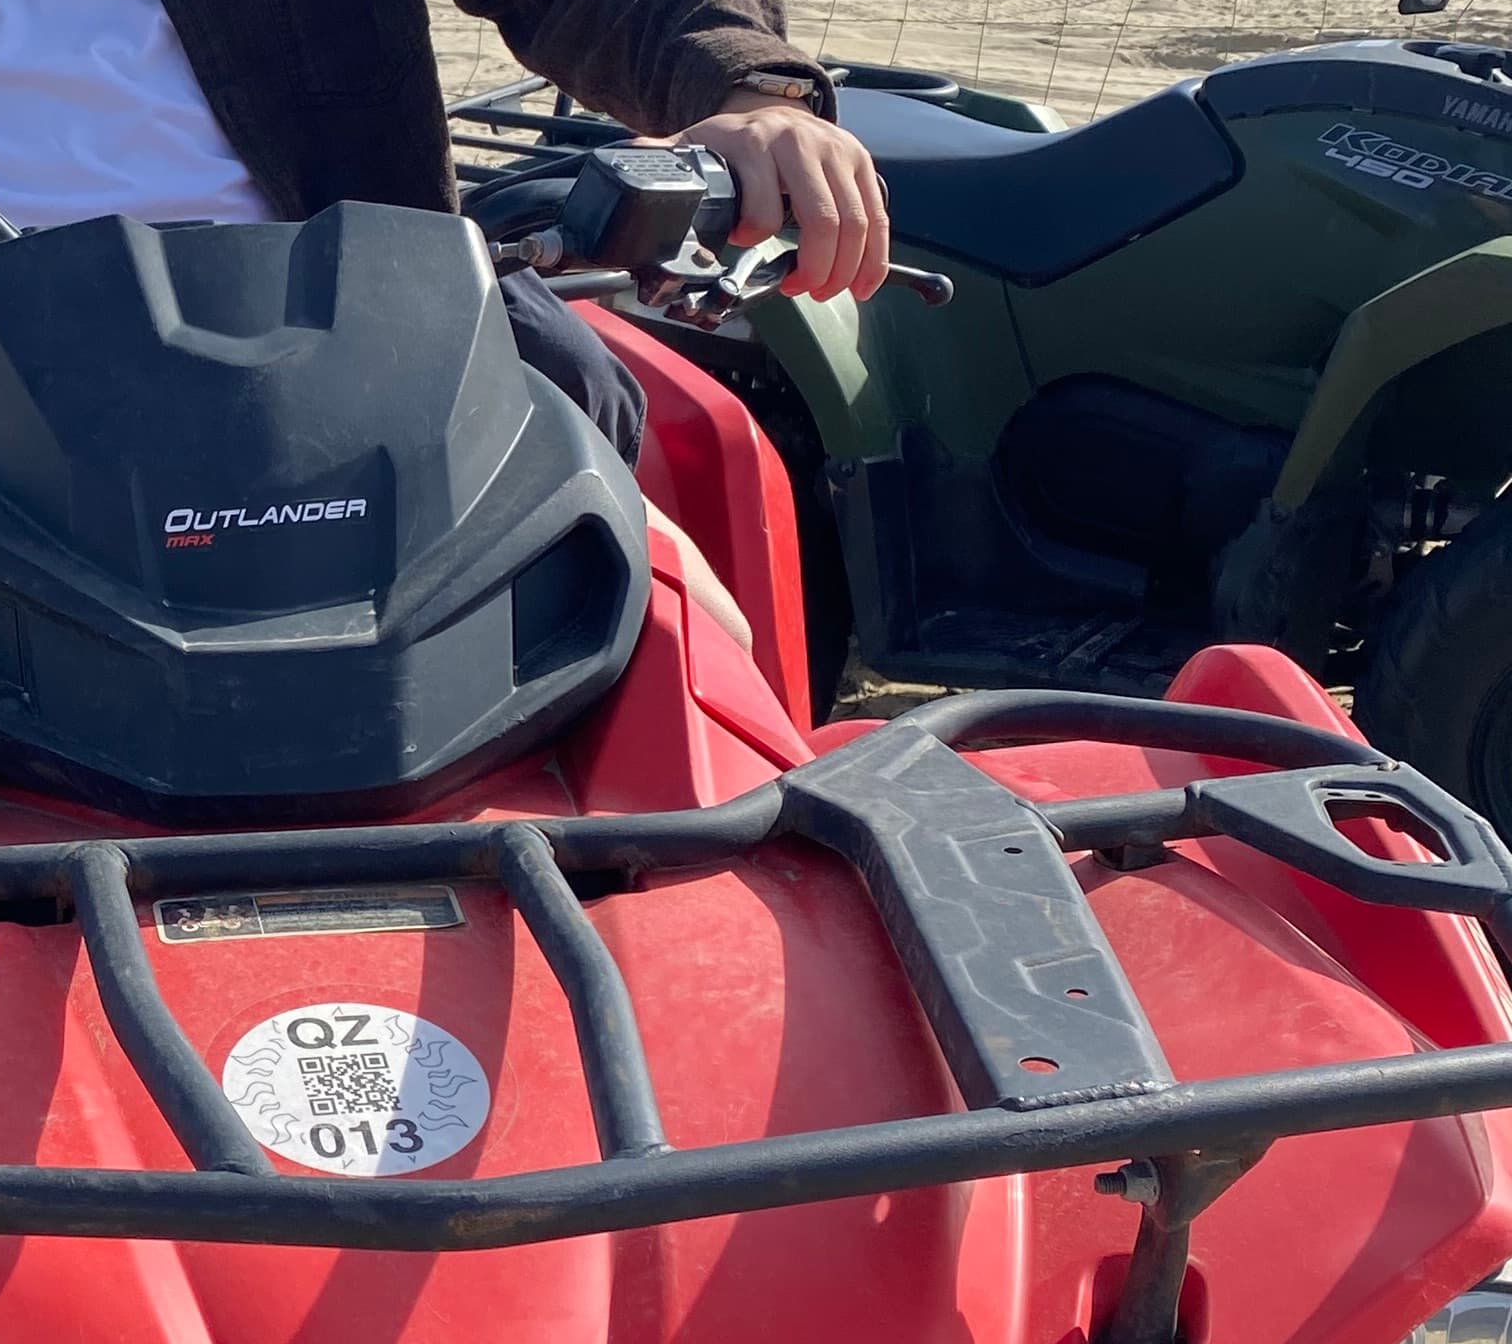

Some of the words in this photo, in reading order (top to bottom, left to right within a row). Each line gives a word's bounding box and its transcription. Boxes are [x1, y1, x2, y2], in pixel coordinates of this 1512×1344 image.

[1317, 122, 1512, 201] KODIA
[1324, 147, 1435, 190] 450
[164, 498, 368, 534] OUTLANDER
[286, 1014, 380, 1051] QZ
[309, 1118, 425, 1159] 013
